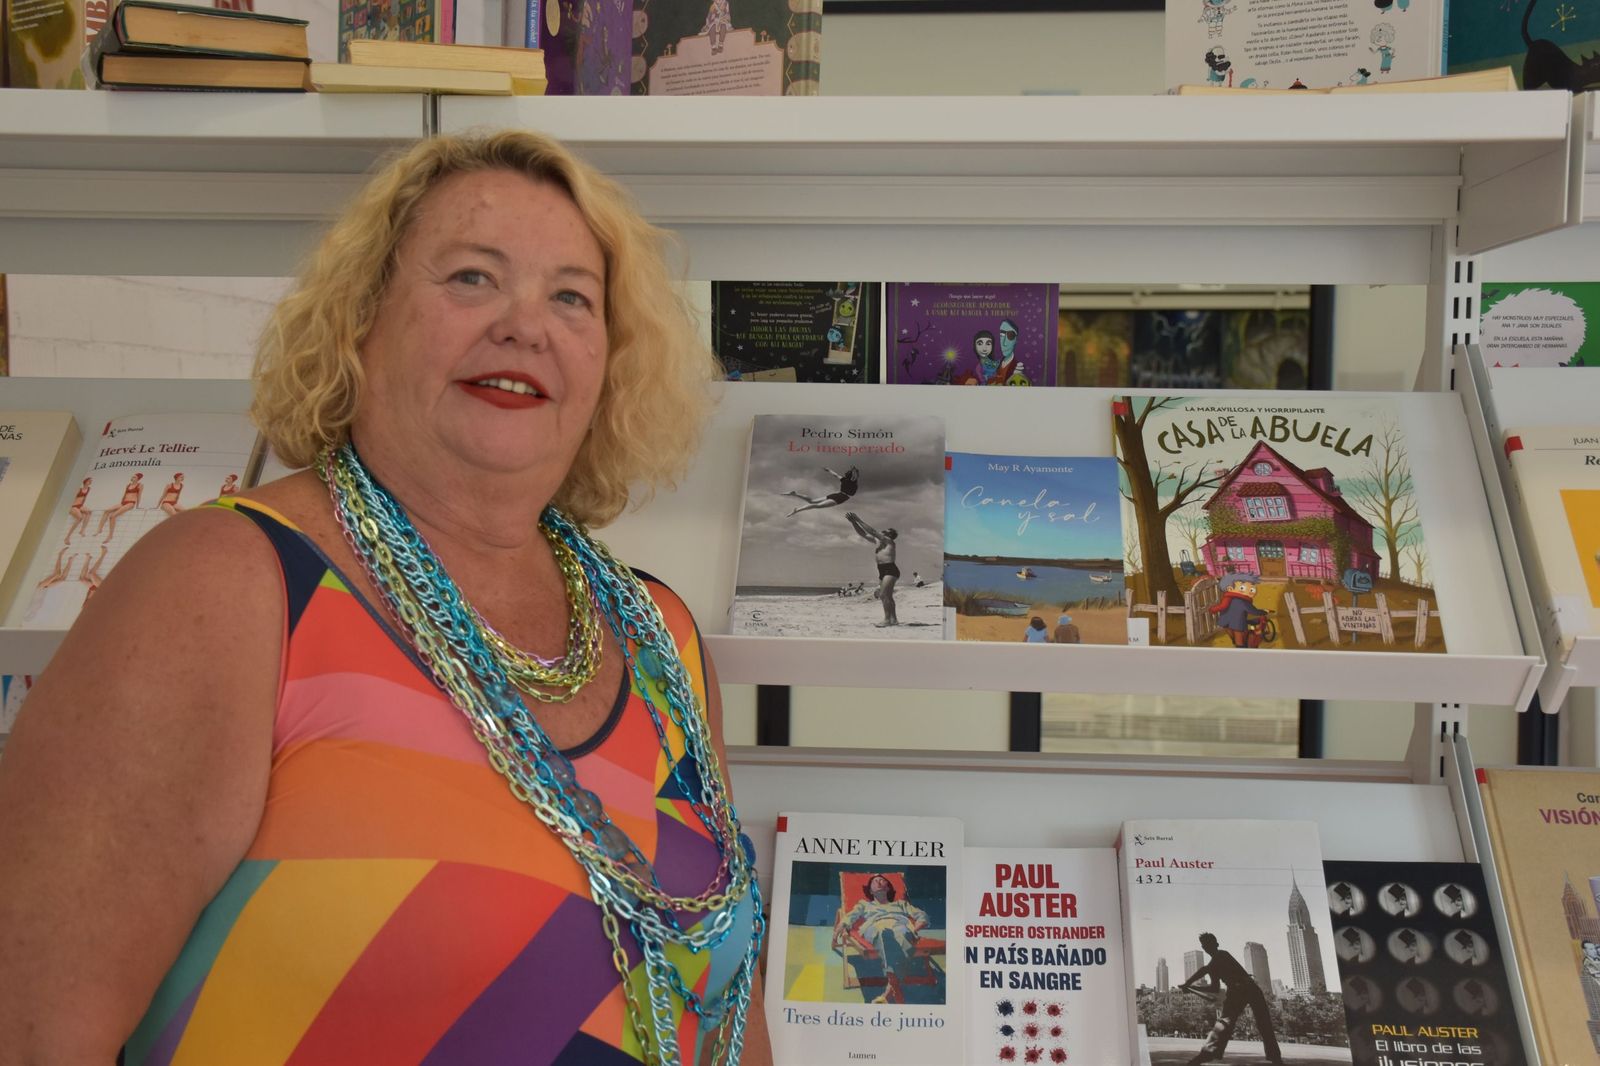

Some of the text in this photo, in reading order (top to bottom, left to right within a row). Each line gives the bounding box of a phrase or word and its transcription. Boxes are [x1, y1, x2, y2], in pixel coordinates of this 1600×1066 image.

[0, 425, 16, 433] DE
[801, 427, 894, 439] Pedro Simón
[1157, 415, 1374, 457] CASA DE LA ABUELA
[788, 441, 906, 457] Lo inesperado
[1573, 437, 1599, 446] JUAN
[99, 443, 200, 457] Hervé Le Tellier
[93, 457, 161, 471] La anomalía
[988, 463, 1074, 475] May R Ayamonte
[960, 485, 1070, 509] Canela
[1017, 502, 1100, 536] y sal
[795, 837, 946, 858] ANNE TYLER
[1135, 857, 1215, 869] Paul Auster
[995, 863, 1060, 889] PAUL
[979, 892, 1078, 918] AUSTER
[965, 925, 1106, 940] SPENCER OSTRANDER
[964, 943, 1107, 966] N PAÍS BAÑADO
[980, 970, 1082, 991] EN SANGRE
[783, 1008, 945, 1031] Tres días de junio
[1372, 1024, 1478, 1039] PAUL AUSTER
[1375, 1040, 1482, 1055] El libro de las
[848, 1051, 877, 1060] Lumen
